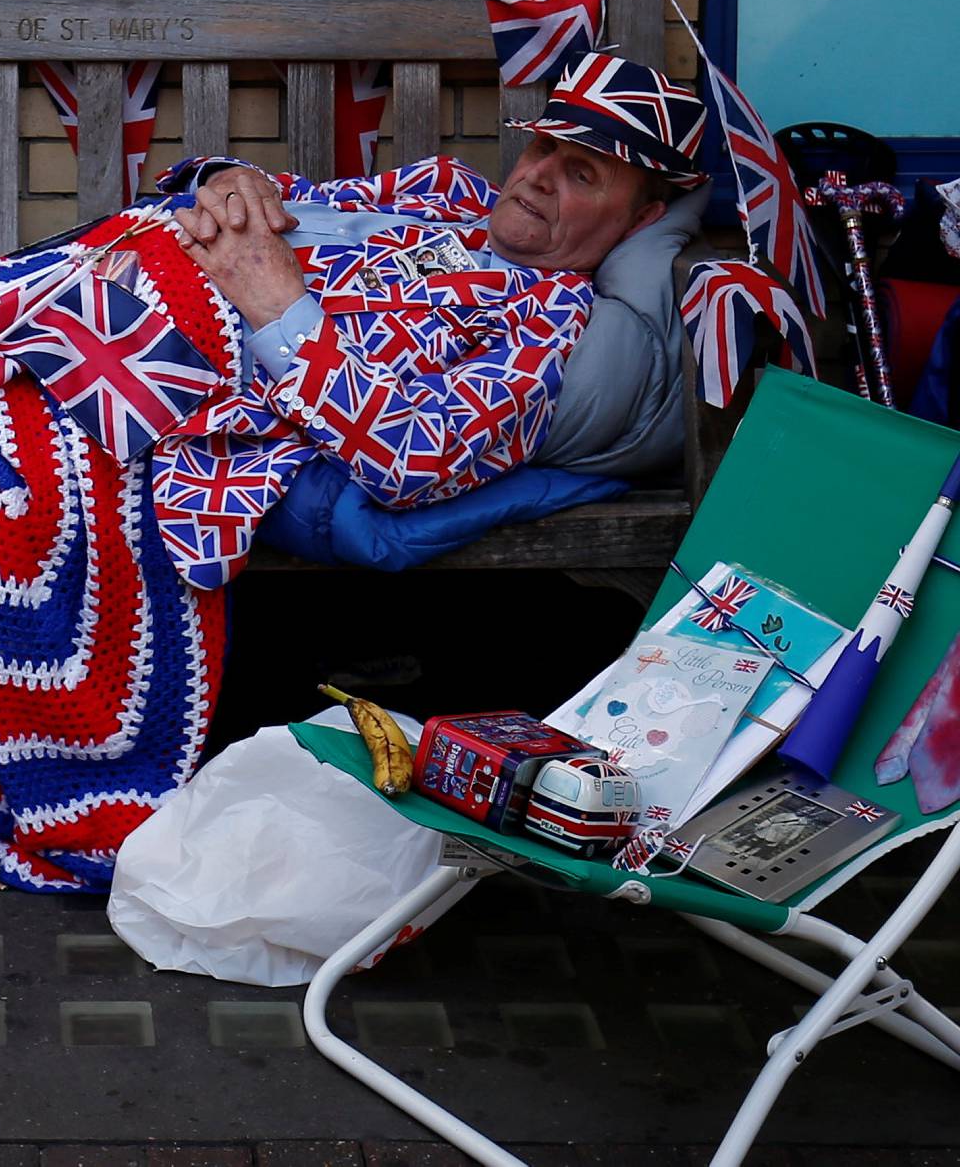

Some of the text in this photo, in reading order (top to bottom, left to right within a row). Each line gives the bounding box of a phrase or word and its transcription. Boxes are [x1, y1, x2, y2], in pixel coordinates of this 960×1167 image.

[17, 17, 48, 41] OF
[60, 17, 97, 41] ST.
[108, 17, 195, 41] MARY'S
[669, 646, 718, 672] Little
[692, 669, 753, 695] Person
[541, 820, 563, 834] PEACE
